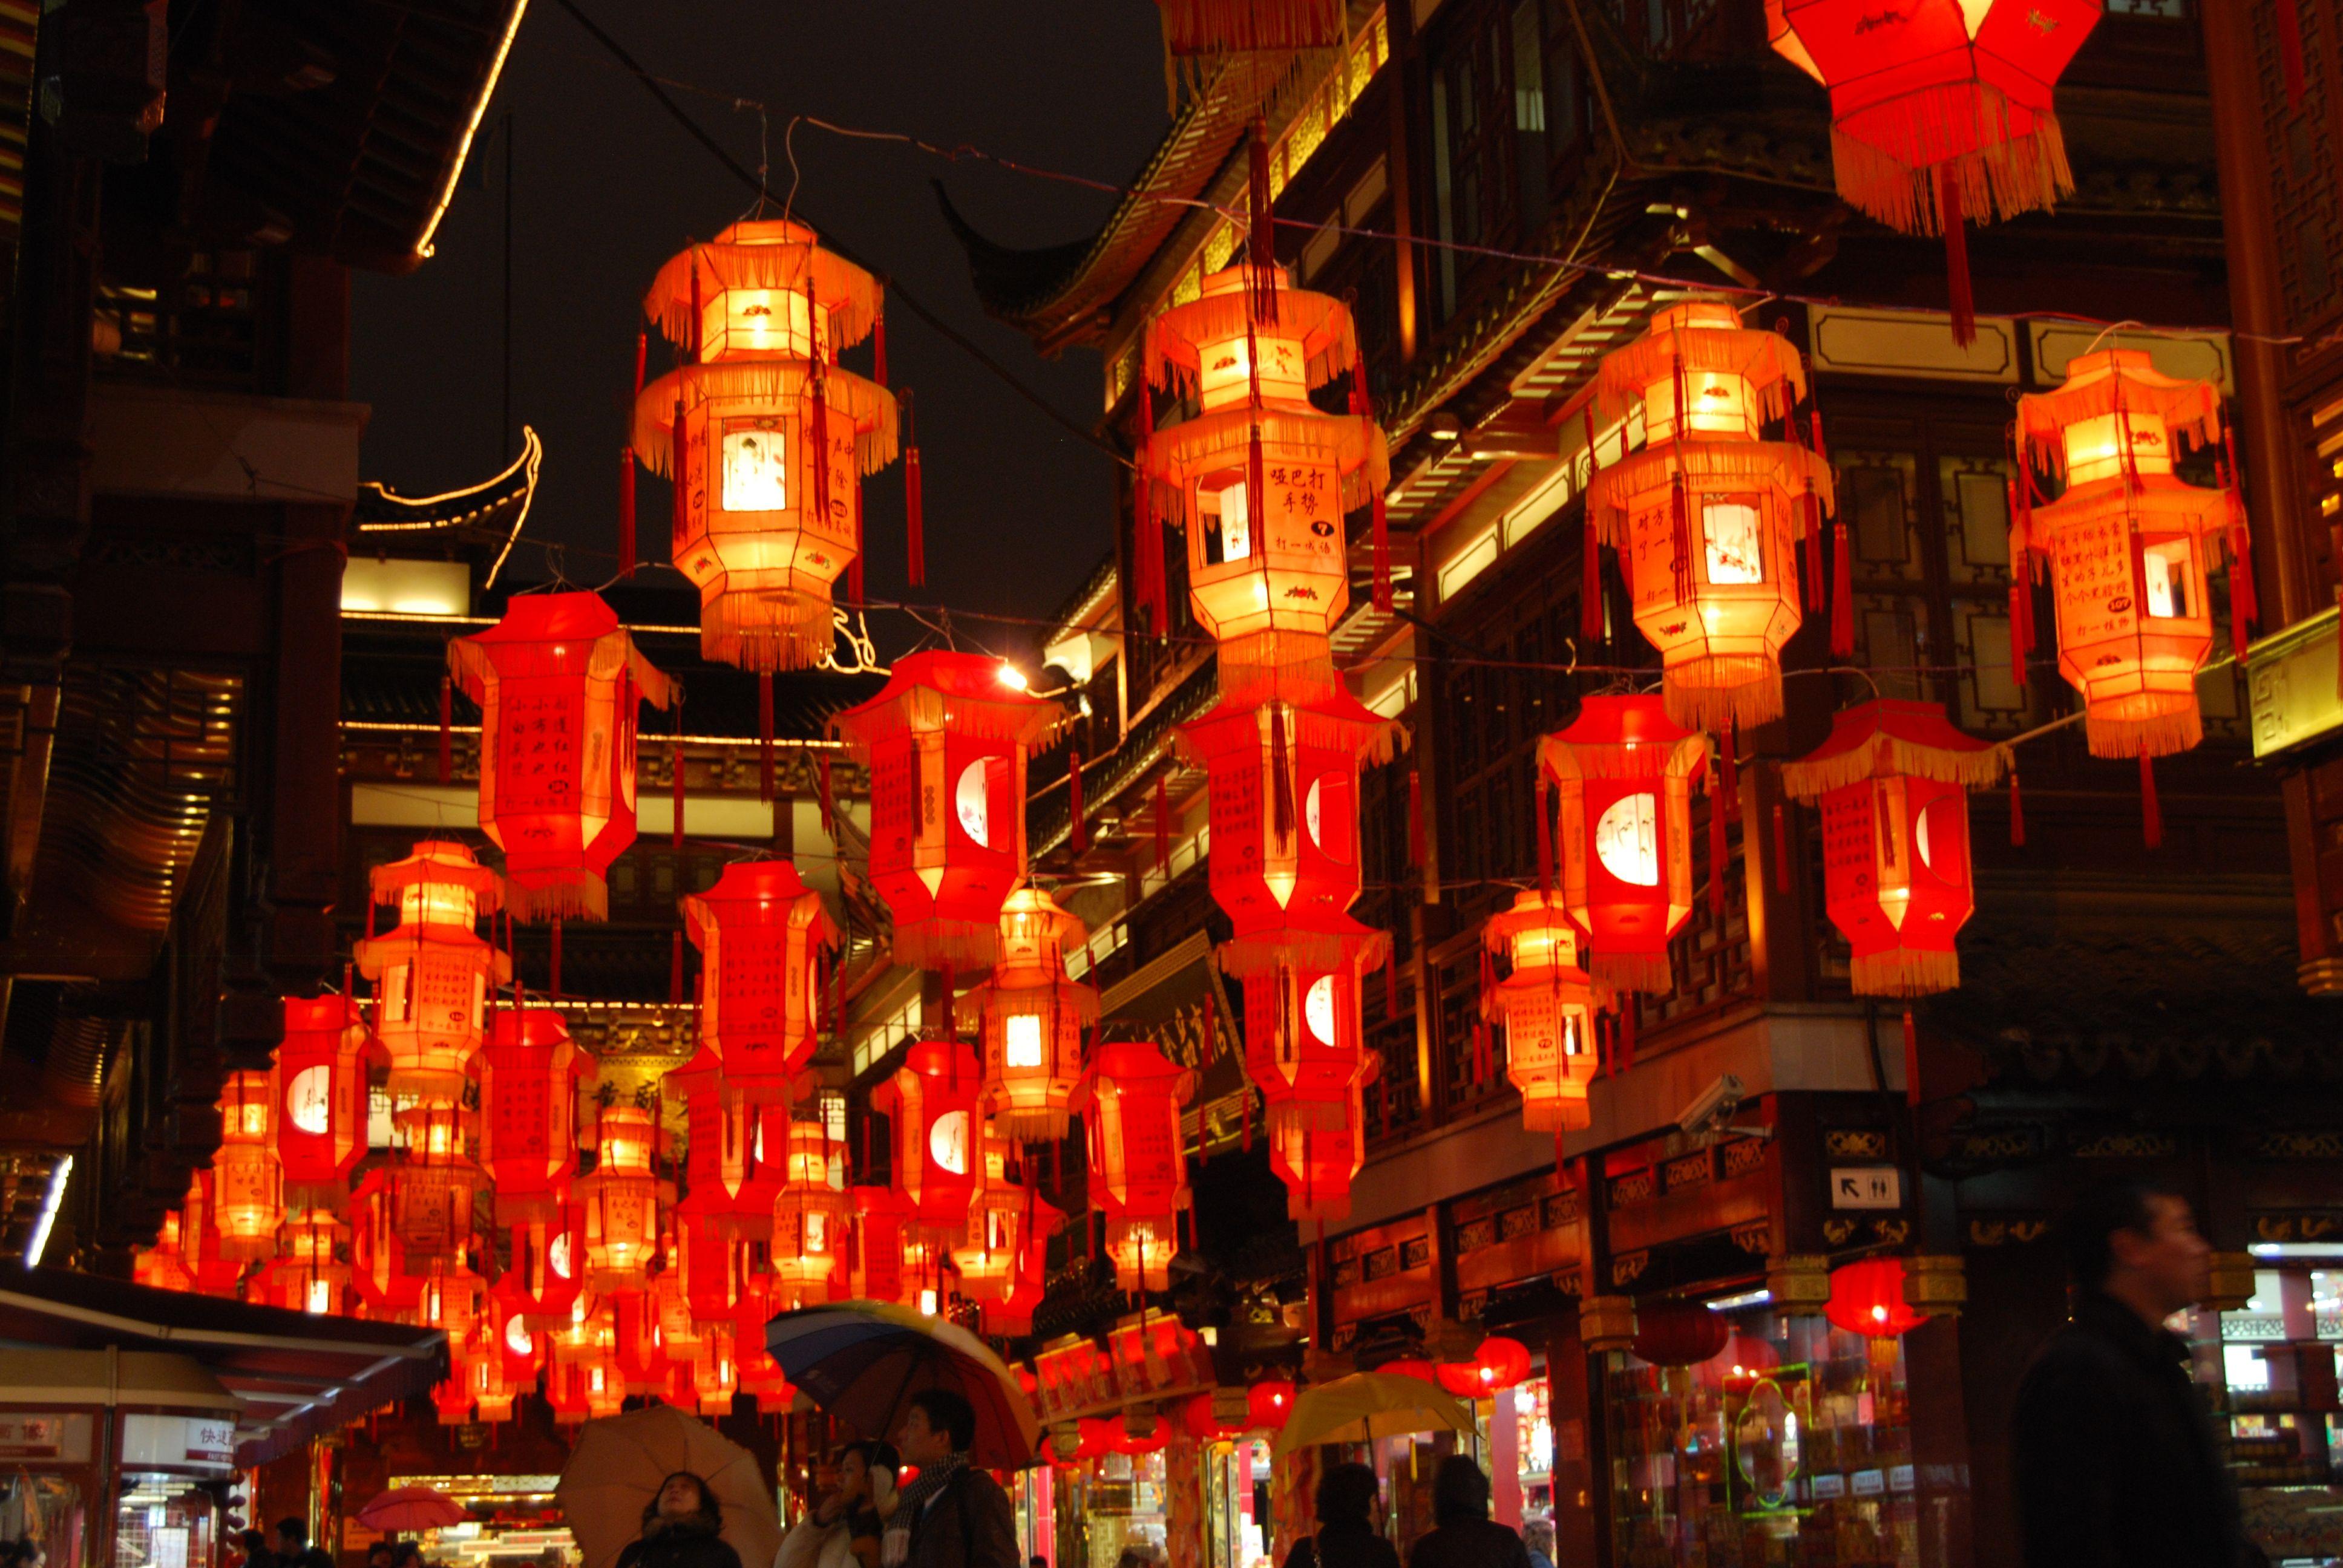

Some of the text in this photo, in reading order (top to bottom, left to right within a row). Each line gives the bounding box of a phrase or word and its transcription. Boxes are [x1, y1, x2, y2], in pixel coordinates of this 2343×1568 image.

[1270, 467, 1325, 490] 哑巴打
[1283, 492, 1318, 516] 手势
[1317, 523, 1328, 535] 7
[1276, 536, 1330, 554] 打一成语
[2111, 598, 2129, 611] 107
